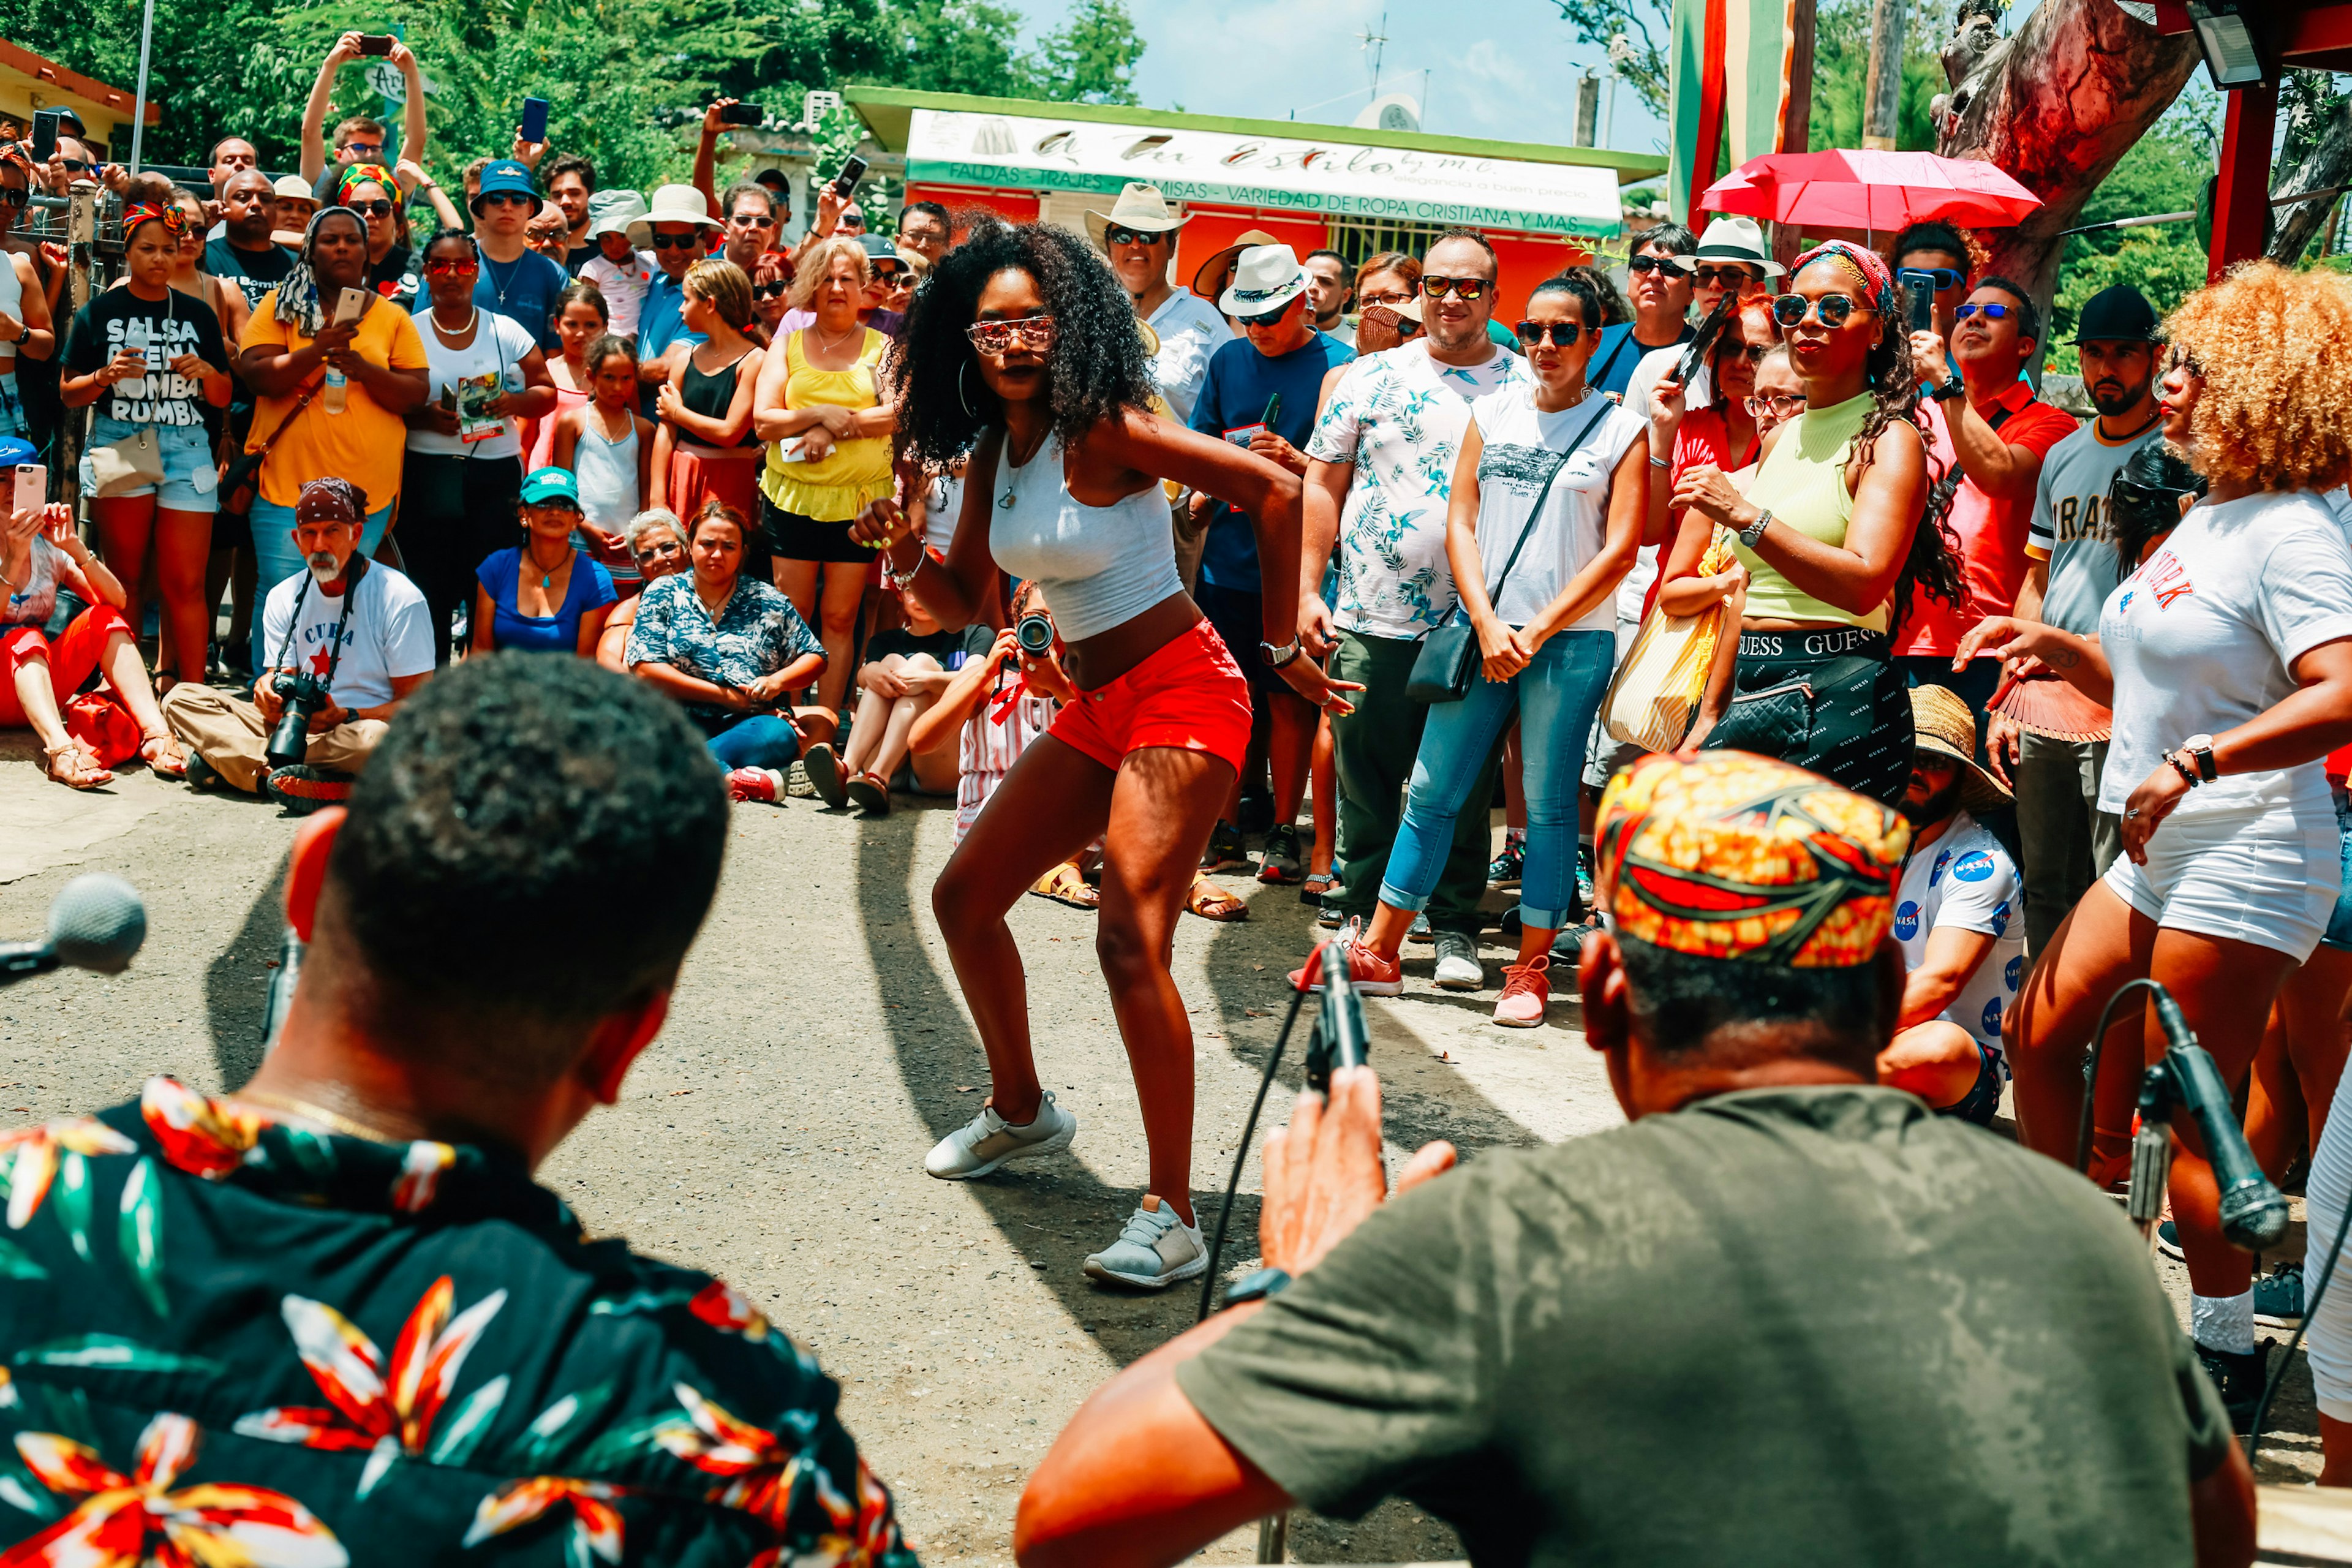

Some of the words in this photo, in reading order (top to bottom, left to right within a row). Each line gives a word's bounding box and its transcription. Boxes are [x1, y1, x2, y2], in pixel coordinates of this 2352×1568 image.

[1220, 141, 1395, 175] Estilo
[1394, 175, 1472, 188] elegancia
[1493, 182, 1533, 195] buen
[949, 163, 1019, 183] FALDAS
[1039, 169, 1103, 189] TRAJES
[1227, 186, 1321, 208] VARIEDAD
[1328, 195, 1351, 211] DE
[1359, 197, 1409, 216] ROPA
[1417, 203, 1511, 225] CRISTIANA
[1519, 211, 1531, 227] Y
[1536, 213, 1578, 232] MAS
[107, 317, 200, 344] SALSA
[111, 399, 205, 426] RUMBA
[1850, 679, 1869, 692] GUESS
[1882, 690, 1896, 702] GUESS
[1815, 699, 1834, 712] GUESS
[1850, 704, 1869, 717] GUESS
[1871, 723, 1889, 734] GUESS
[1839, 735, 1861, 747] GUESS
[1869, 746, 1887, 758] GUESS
[1801, 754, 1820, 766] GUESS
[1833, 760, 1853, 772] GUESS
[1851, 778, 1871, 791] GUESS
[1956, 859, 1992, 873] NASA
[1895, 916, 1917, 926] NASA
